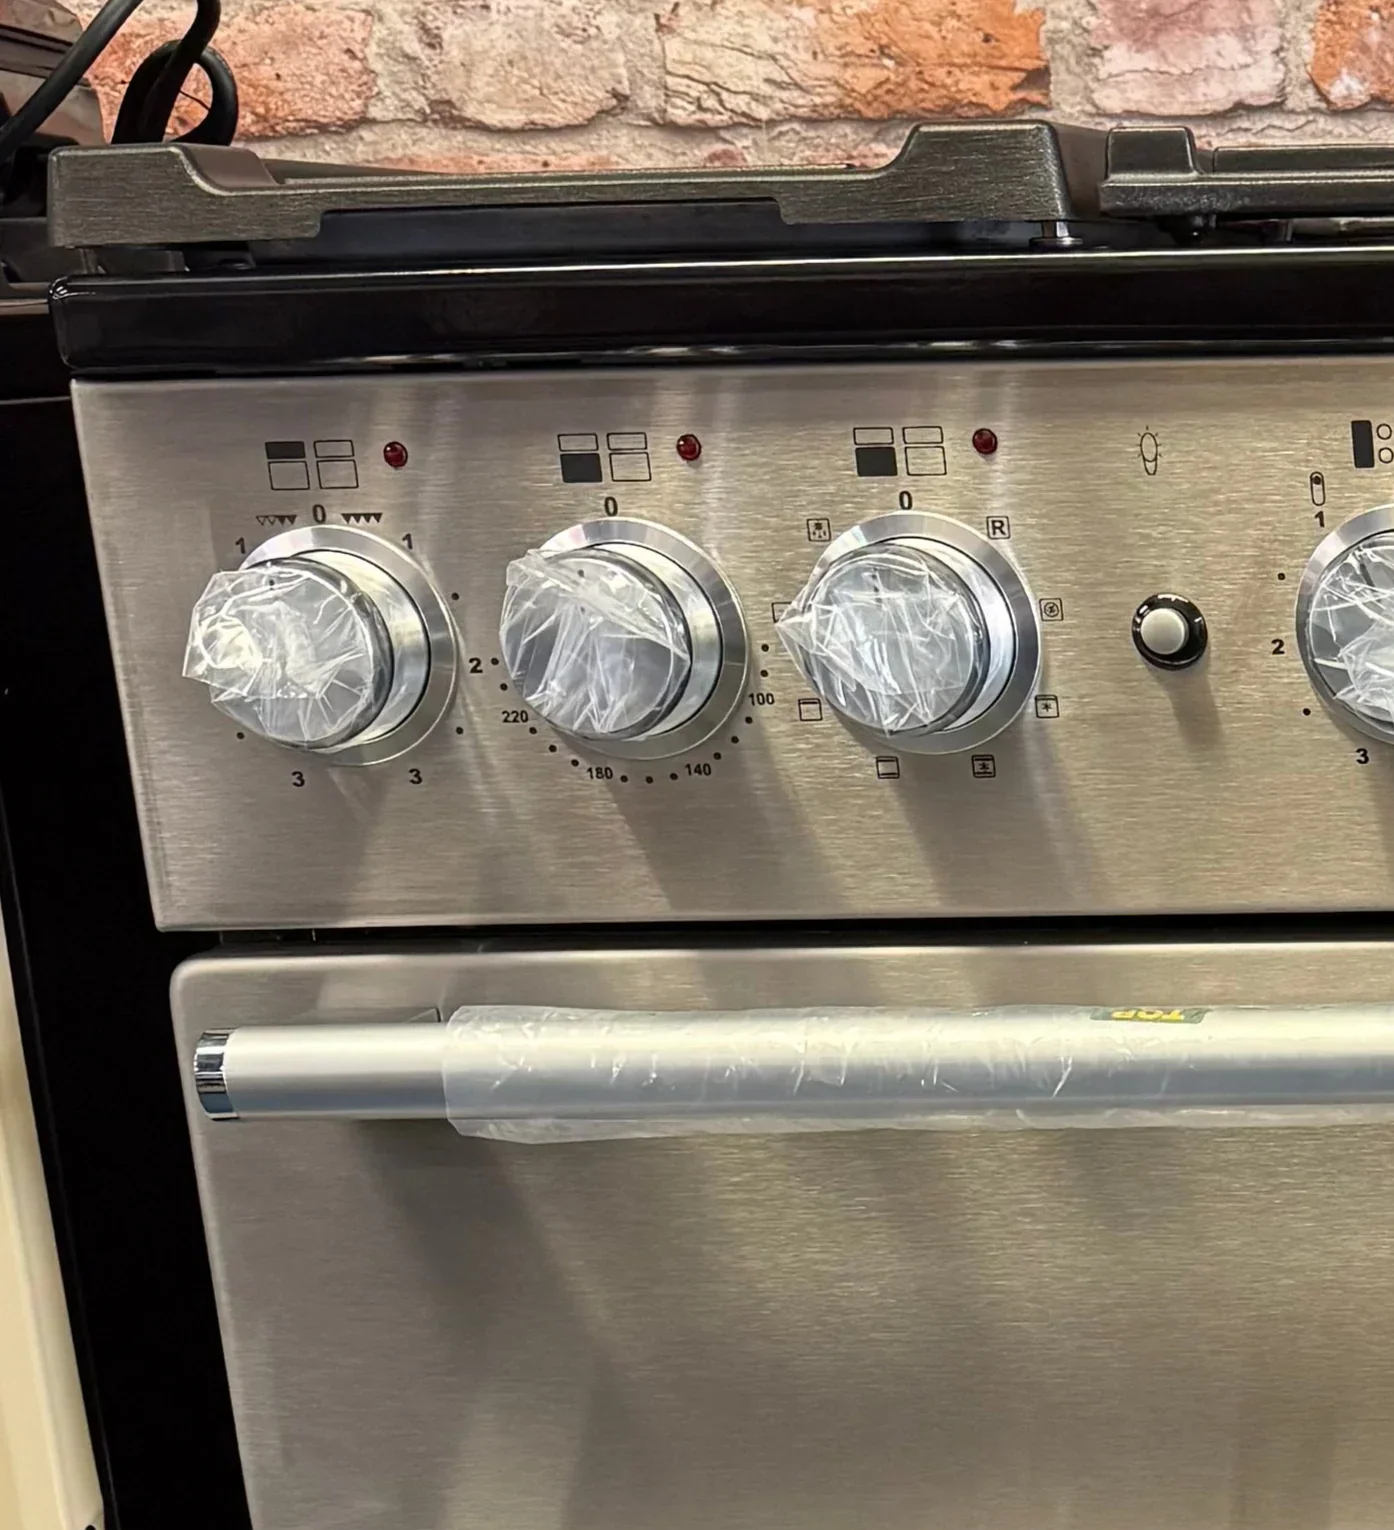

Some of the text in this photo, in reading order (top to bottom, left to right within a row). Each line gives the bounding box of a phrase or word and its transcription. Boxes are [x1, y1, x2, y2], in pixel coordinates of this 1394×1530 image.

[604, 496, 618, 517] 0
[898, 491, 912, 511] 0
[312, 503, 326, 525] 0
[1315, 511, 1326, 528] 1
[990, 519, 1007, 537] R
[235, 536, 247, 554] 1
[402, 533, 414, 550] 1
[1271, 639, 1285, 656] 2
[468, 657, 483, 674] 2
[749, 693, 775, 707] 100
[502, 709, 528, 725] 220
[1355, 748, 1369, 765] 3
[408, 768, 423, 785] 3
[587, 766, 614, 781] 180
[685, 763, 711, 778] 140
[292, 771, 306, 788] 3
